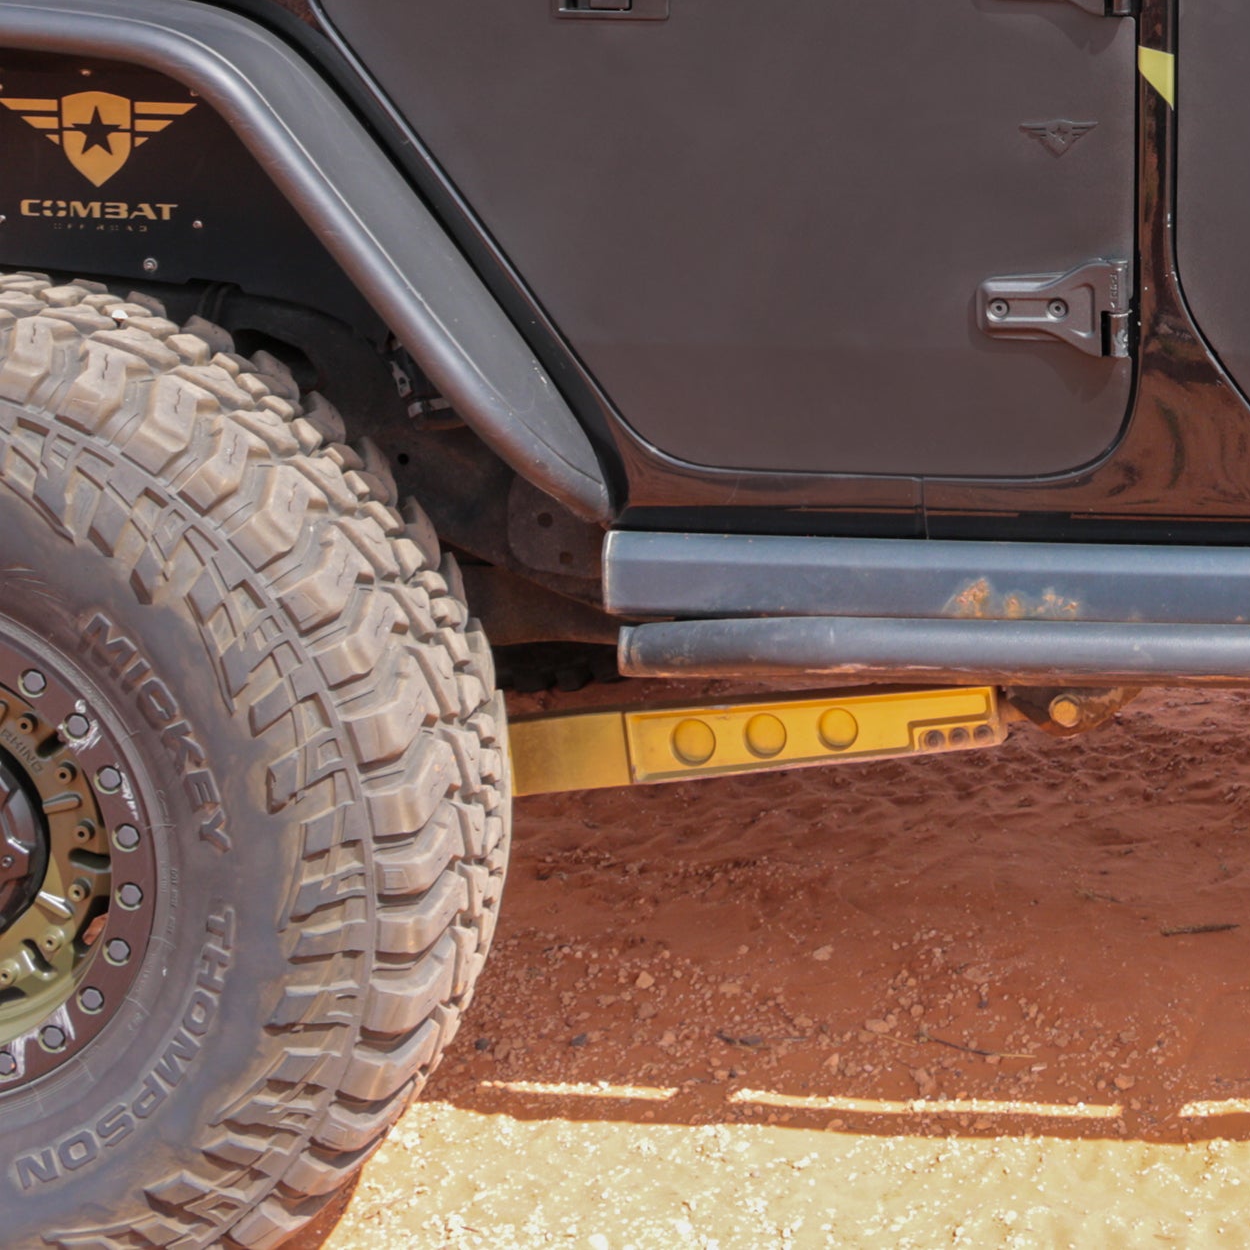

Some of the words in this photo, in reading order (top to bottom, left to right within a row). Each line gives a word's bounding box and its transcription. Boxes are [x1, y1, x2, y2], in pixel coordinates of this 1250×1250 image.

[20, 199, 179, 220] COMBAT
[80, 612, 231, 853] MICKEY
[15, 905, 235, 1191] THOMPSON
